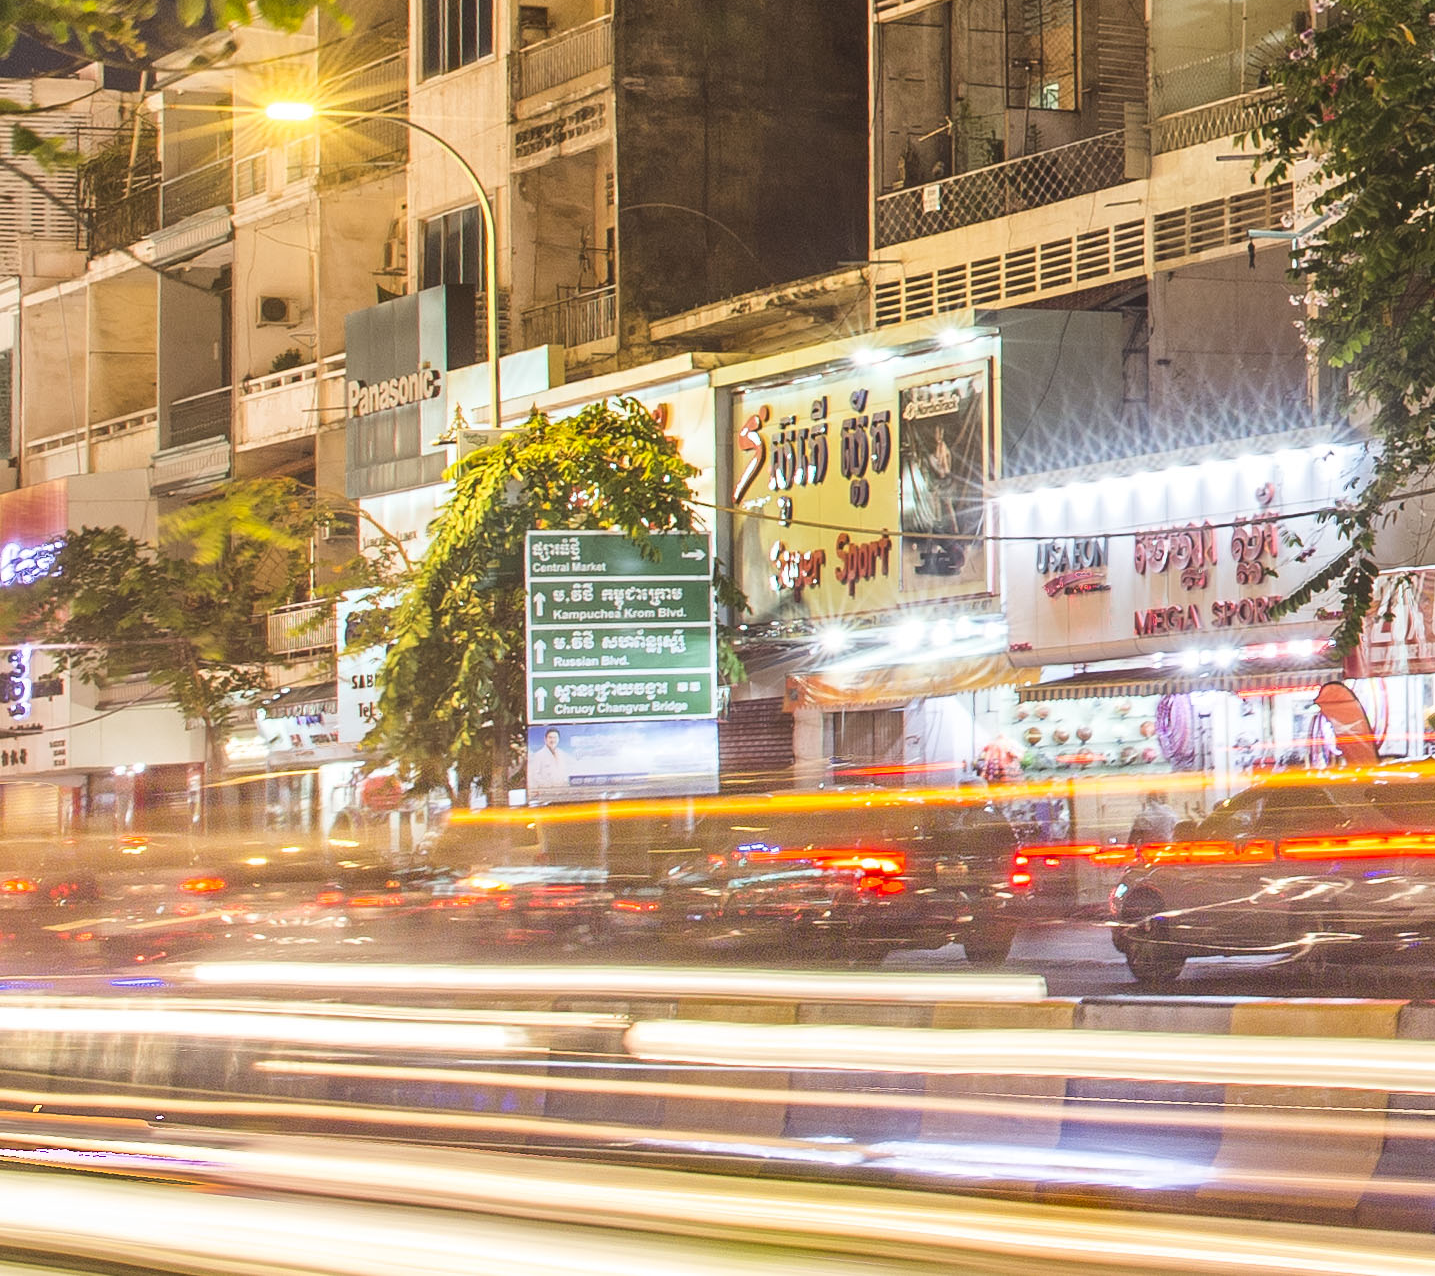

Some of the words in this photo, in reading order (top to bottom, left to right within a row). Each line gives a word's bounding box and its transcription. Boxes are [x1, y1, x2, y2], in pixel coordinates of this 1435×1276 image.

[347, 368, 442, 418] Panasonic
[532, 562, 569, 572] Central
[571, 562, 607, 572] Market
[769, 539, 826, 603] Super
[835, 529, 892, 599] Sport
[553, 610, 621, 621] Kampuchea
[624, 609, 655, 619] Krom
[657, 608, 687, 618] Blvd.
[1134, 604, 1201, 636] MEGA
[553, 656, 599, 667] Russian
[601, 655, 630, 666] Blvd.
[554, 703, 594, 715] Chruoy
[597, 701, 650, 714] Changvar
[651, 700, 688, 713] Bridge
